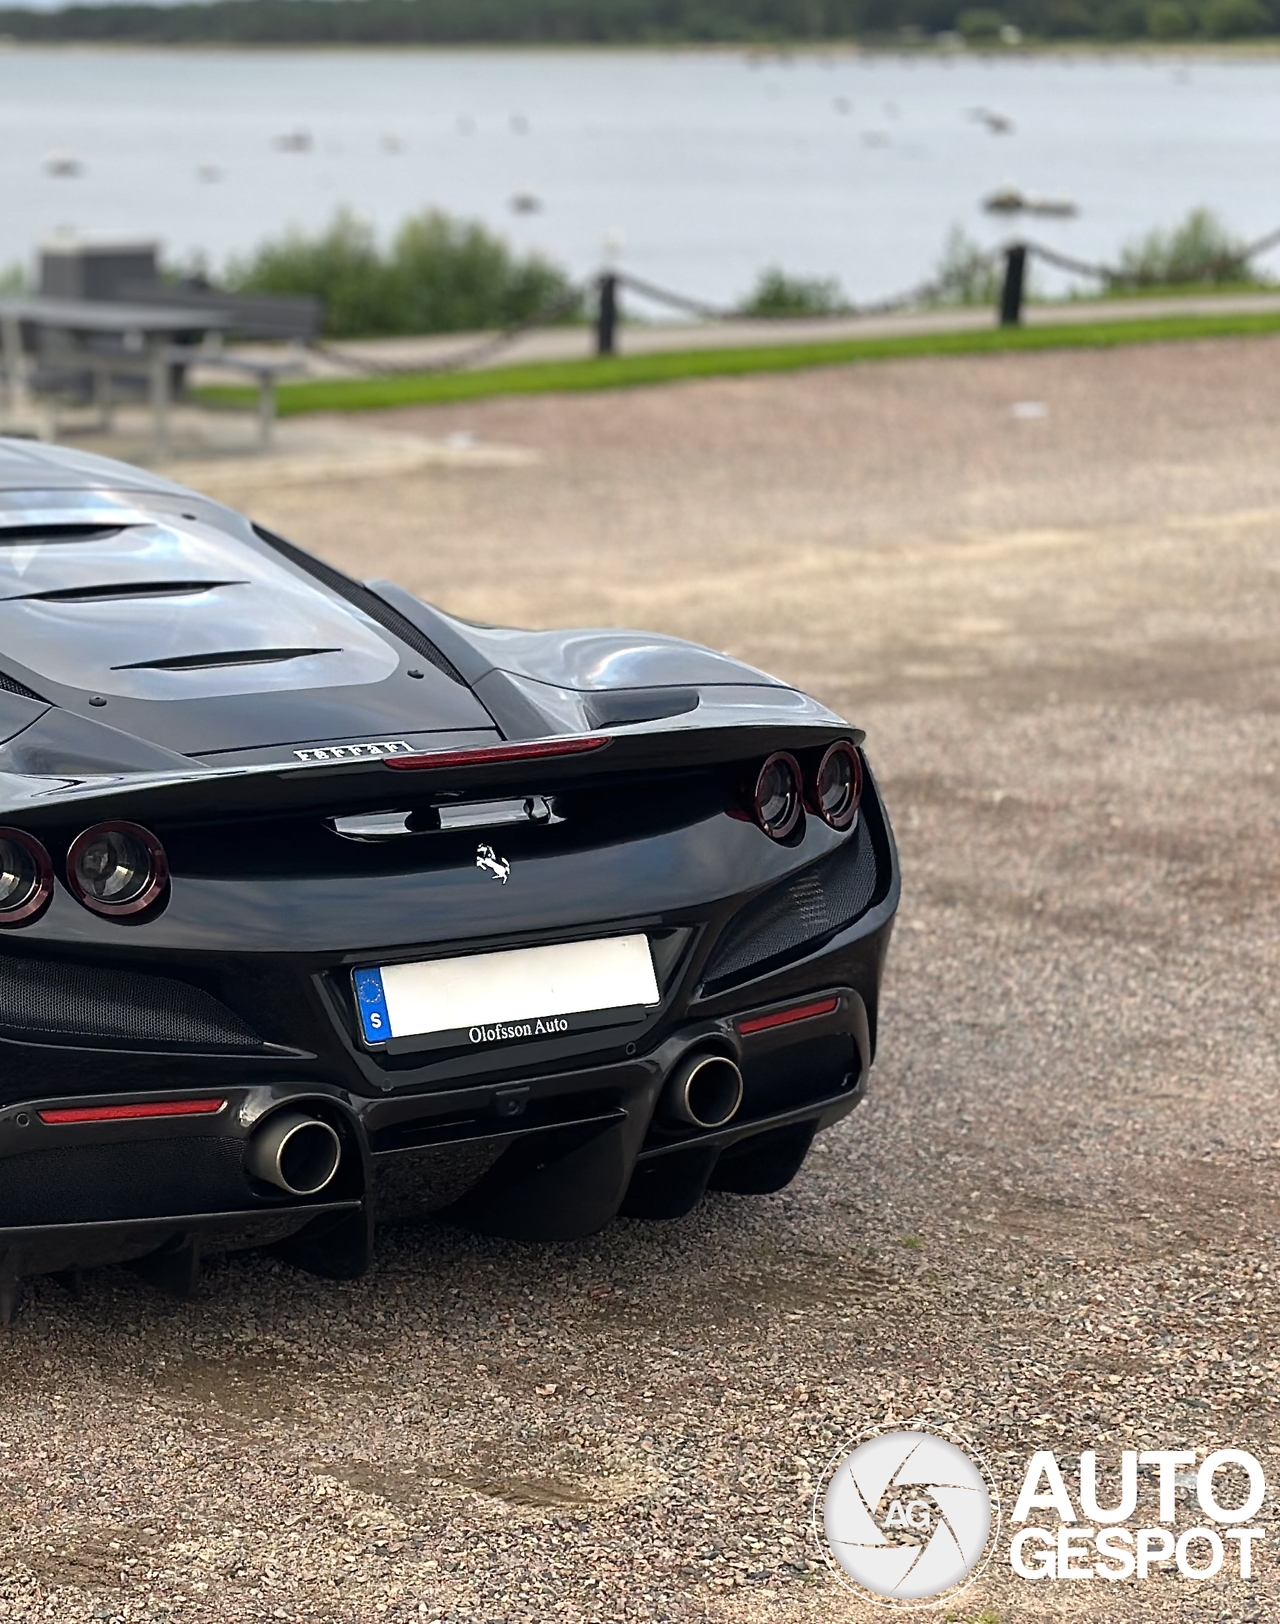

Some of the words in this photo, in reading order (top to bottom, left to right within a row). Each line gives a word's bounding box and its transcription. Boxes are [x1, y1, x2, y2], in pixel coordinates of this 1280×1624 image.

[293, 740, 415, 761] Ferrari
[370, 1013, 382, 1029] S
[468, 1023, 533, 1043] Olofsson
[534, 1018, 568, 1035] Auto
